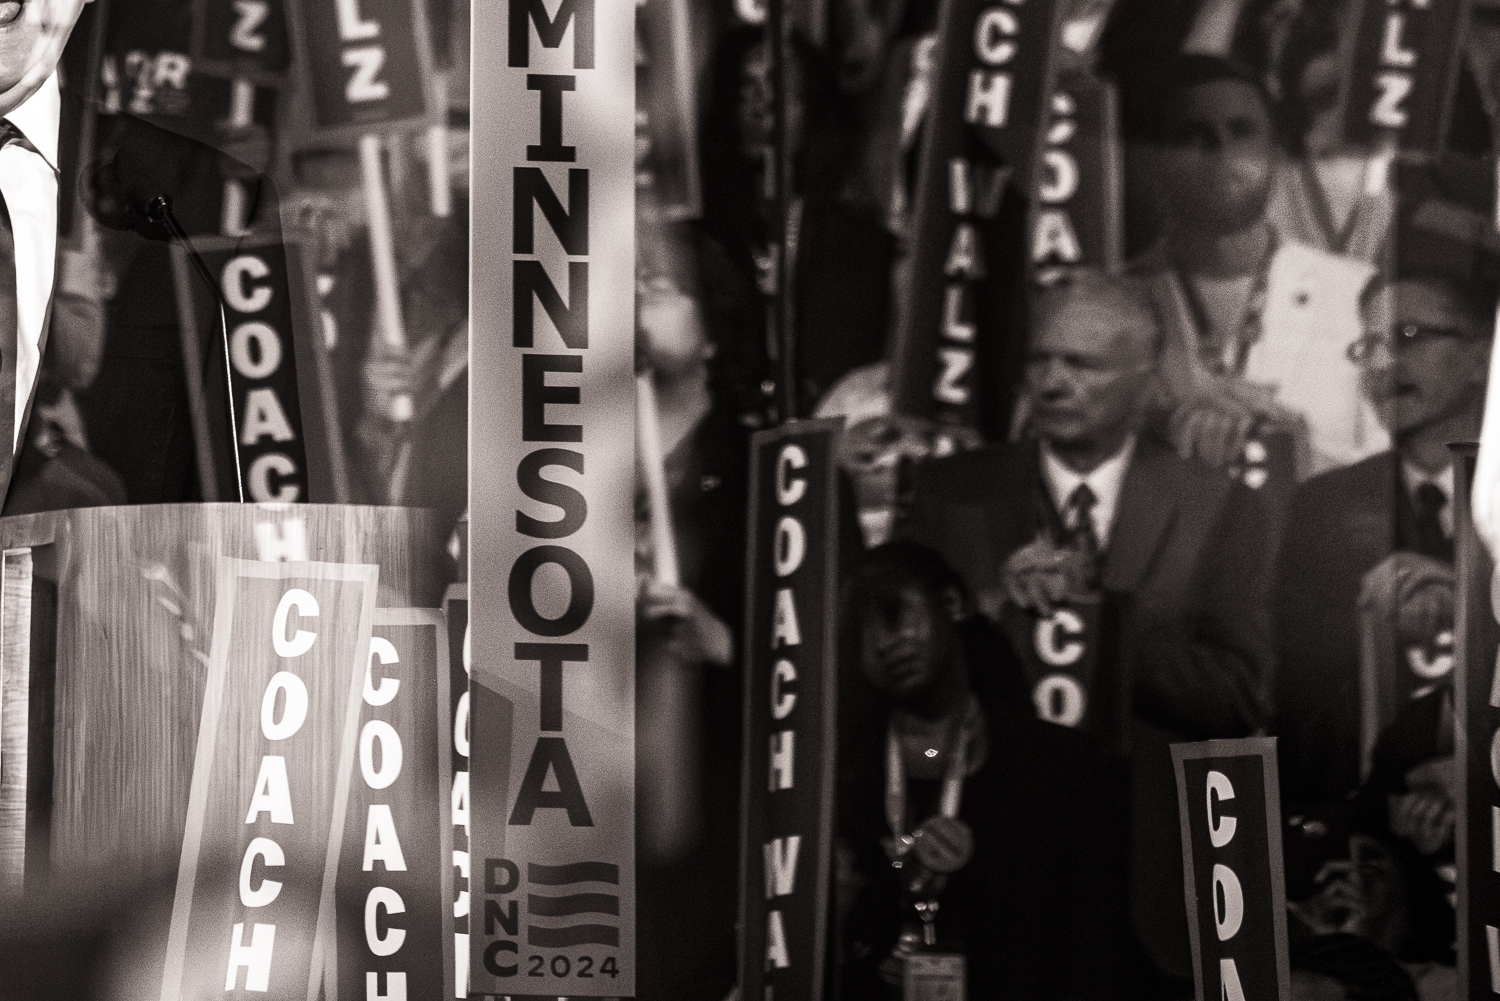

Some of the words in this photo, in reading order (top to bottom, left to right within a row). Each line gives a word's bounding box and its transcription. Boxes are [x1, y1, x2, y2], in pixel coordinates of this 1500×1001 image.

[219, 255, 309, 562] COACH
[765, 444, 807, 793] COACH
[224, 587, 321, 993] COACH
[483, 857, 520, 978] DNC
[527, 954, 620, 979] 2024
[763, 834, 801, 1001] WA
